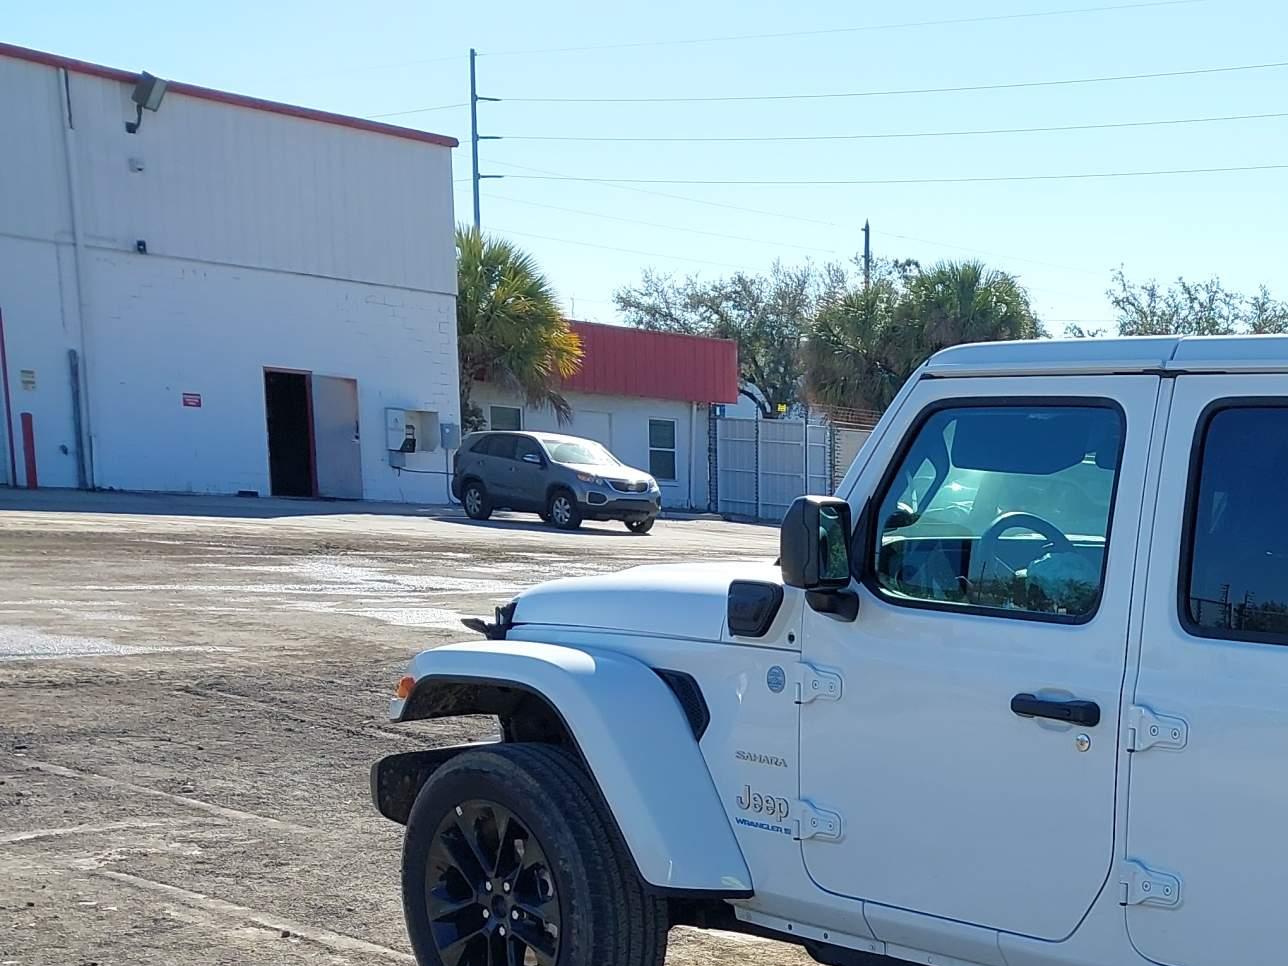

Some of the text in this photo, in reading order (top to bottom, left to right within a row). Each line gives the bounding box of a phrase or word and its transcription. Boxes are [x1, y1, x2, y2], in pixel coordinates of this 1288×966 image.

[735, 750, 788, 768] SAHARA
[735, 784, 789, 822] Jeep
[735, 817, 783, 832] WRANGLER
